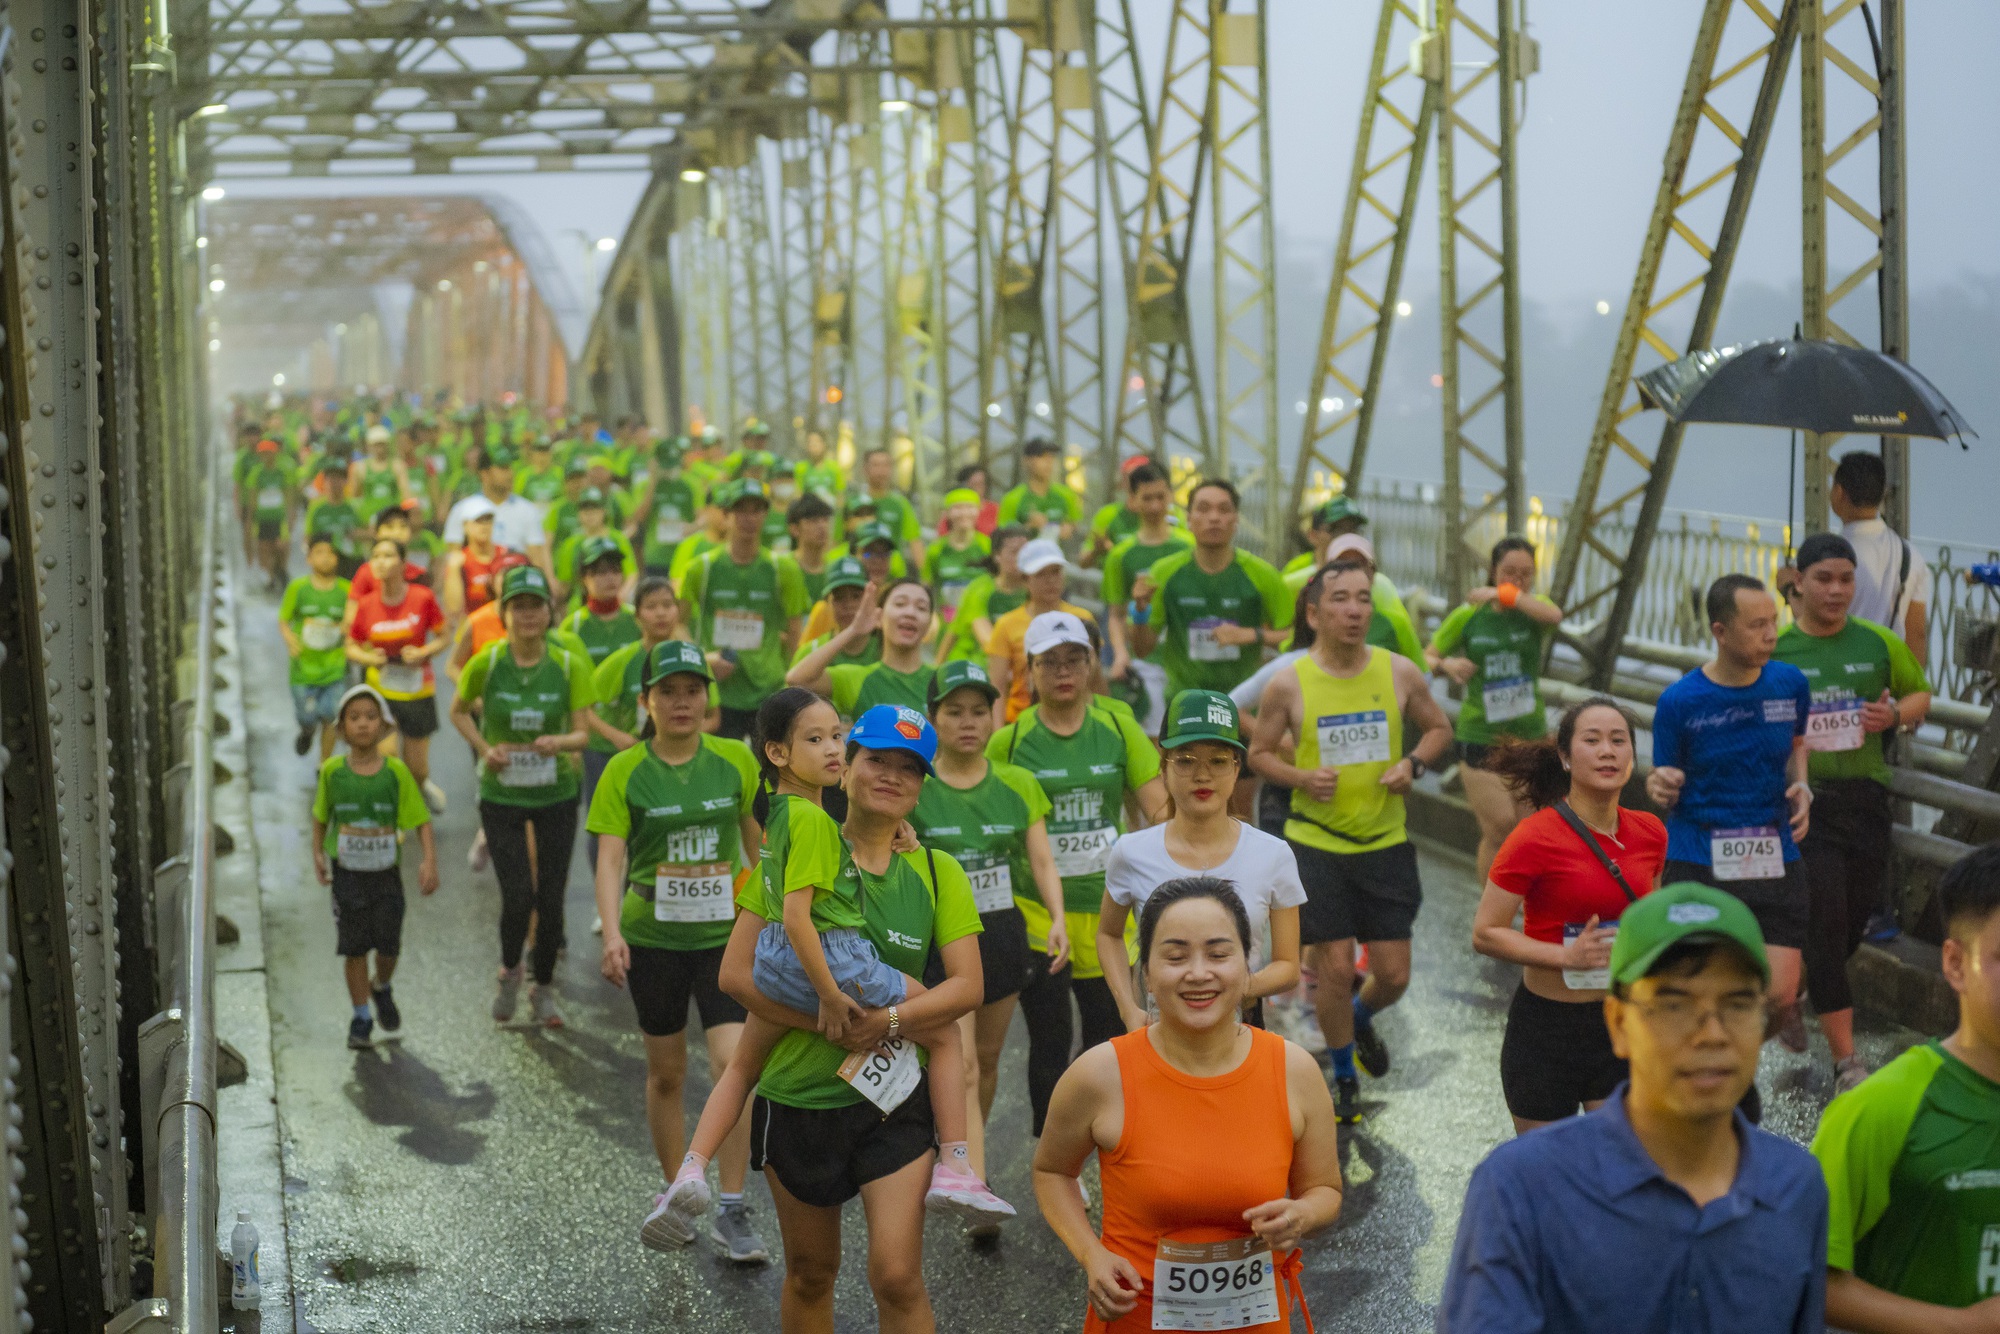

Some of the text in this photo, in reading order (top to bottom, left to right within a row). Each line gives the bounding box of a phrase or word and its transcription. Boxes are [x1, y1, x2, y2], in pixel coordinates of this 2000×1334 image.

[1207, 710, 1233, 729] HUE
[1329, 724, 1379, 746] 61053
[1054, 801, 1103, 823] HUE
[667, 827, 719, 844] IMPERIAL
[667, 838, 720, 863] HUE
[1722, 840, 1775, 857] 80745
[667, 879, 723, 898] 51656
[968, 870, 999, 891] 121
[1168, 1259, 1264, 1294] 50968
